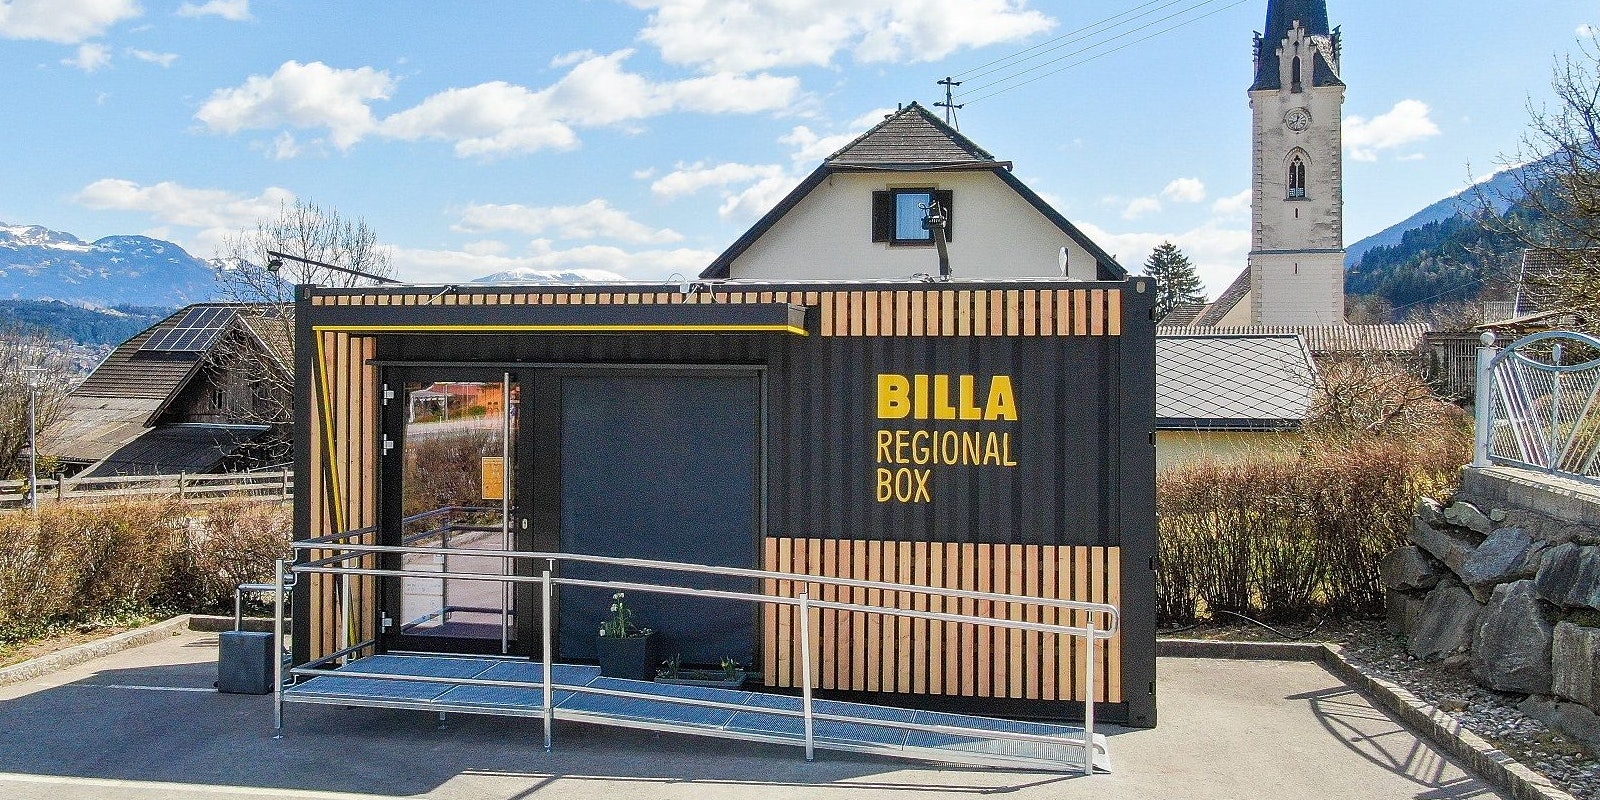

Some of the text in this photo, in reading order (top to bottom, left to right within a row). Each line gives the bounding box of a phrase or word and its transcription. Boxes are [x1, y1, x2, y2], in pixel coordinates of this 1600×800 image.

[877, 374, 1018, 421] BILLA
[877, 430, 1017, 466] REGIONAL
[877, 468, 931, 503] BOX
